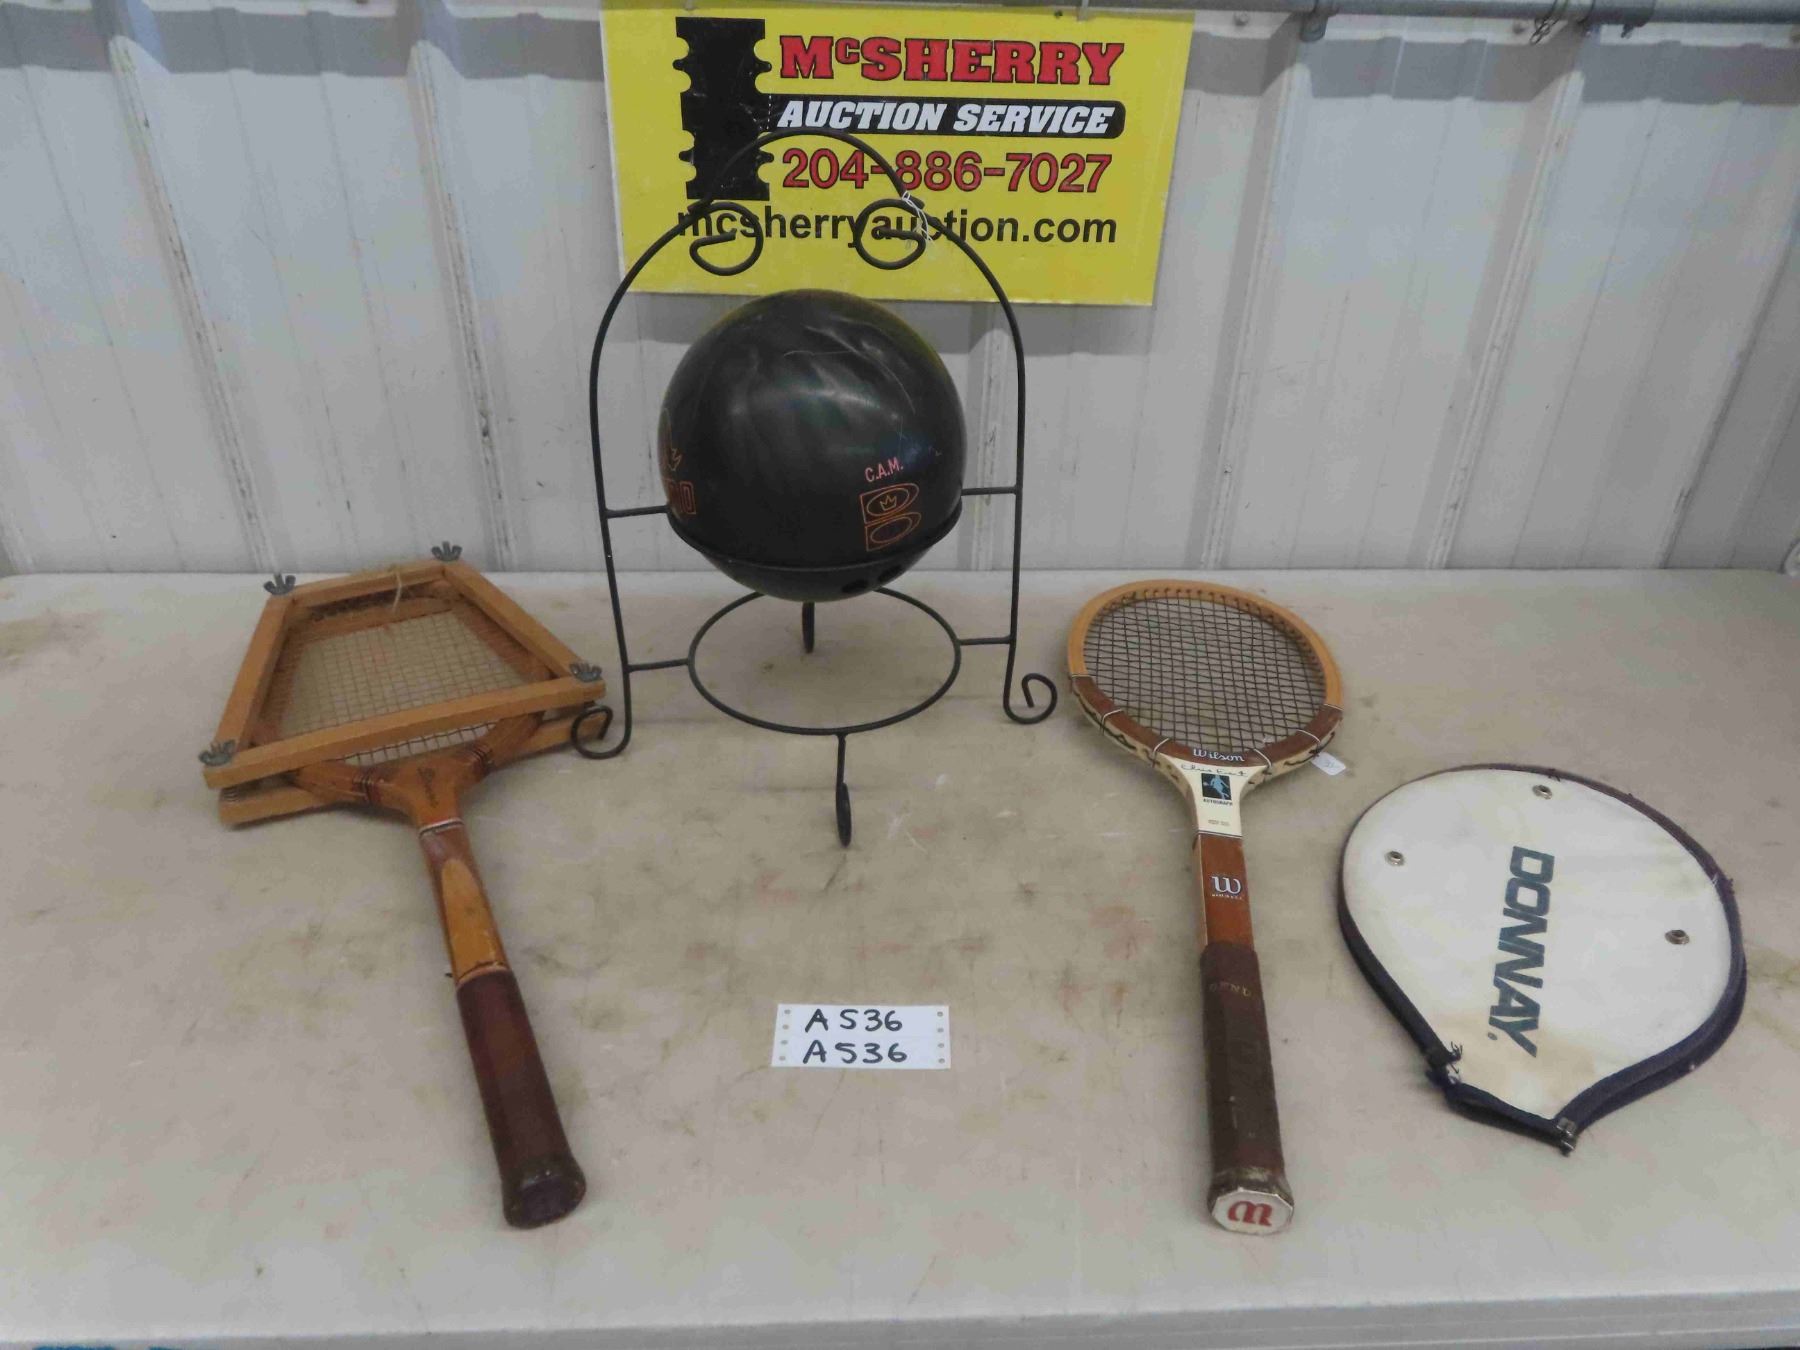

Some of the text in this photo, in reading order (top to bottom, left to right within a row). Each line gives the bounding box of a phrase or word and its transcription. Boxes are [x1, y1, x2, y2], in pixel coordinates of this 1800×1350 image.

[779, 35, 1125, 86] McSHERRY
[776, 99, 1116, 135] AUCTION SERVICE
[781, 147, 1113, 194] 204-886-7027
[864, 456, 904, 483] C.A.M.
[1192, 748, 1246, 762] Wilson
